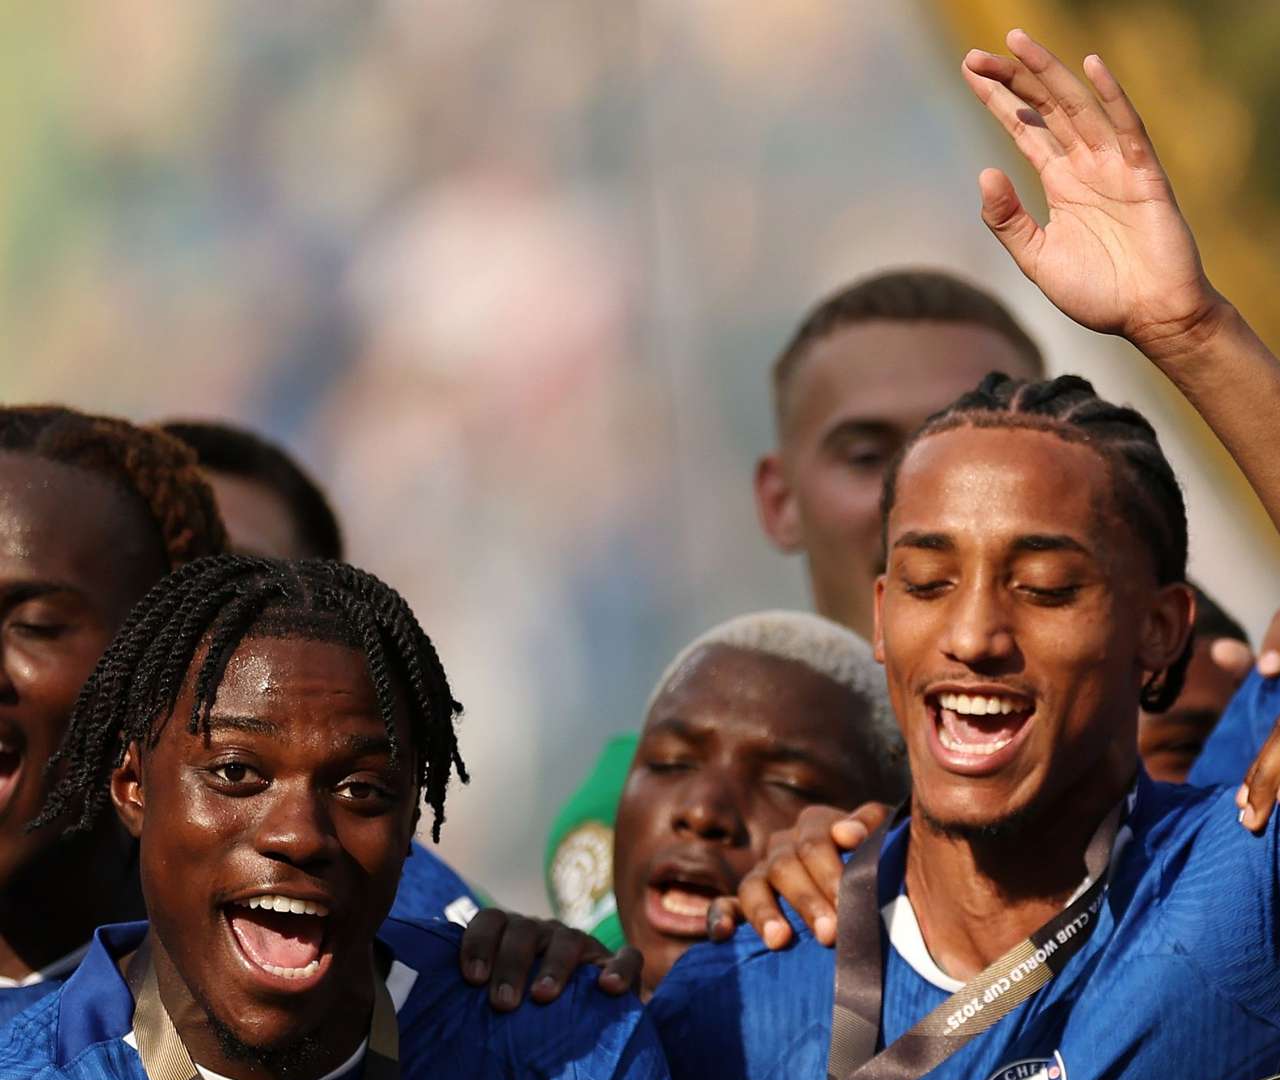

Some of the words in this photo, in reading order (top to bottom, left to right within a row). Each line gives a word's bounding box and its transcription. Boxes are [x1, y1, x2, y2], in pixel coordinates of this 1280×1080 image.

[1057, 911, 1090, 945] CLUB
[1010, 940, 1059, 984] WORLD
[983, 977, 1012, 1004] CUP
